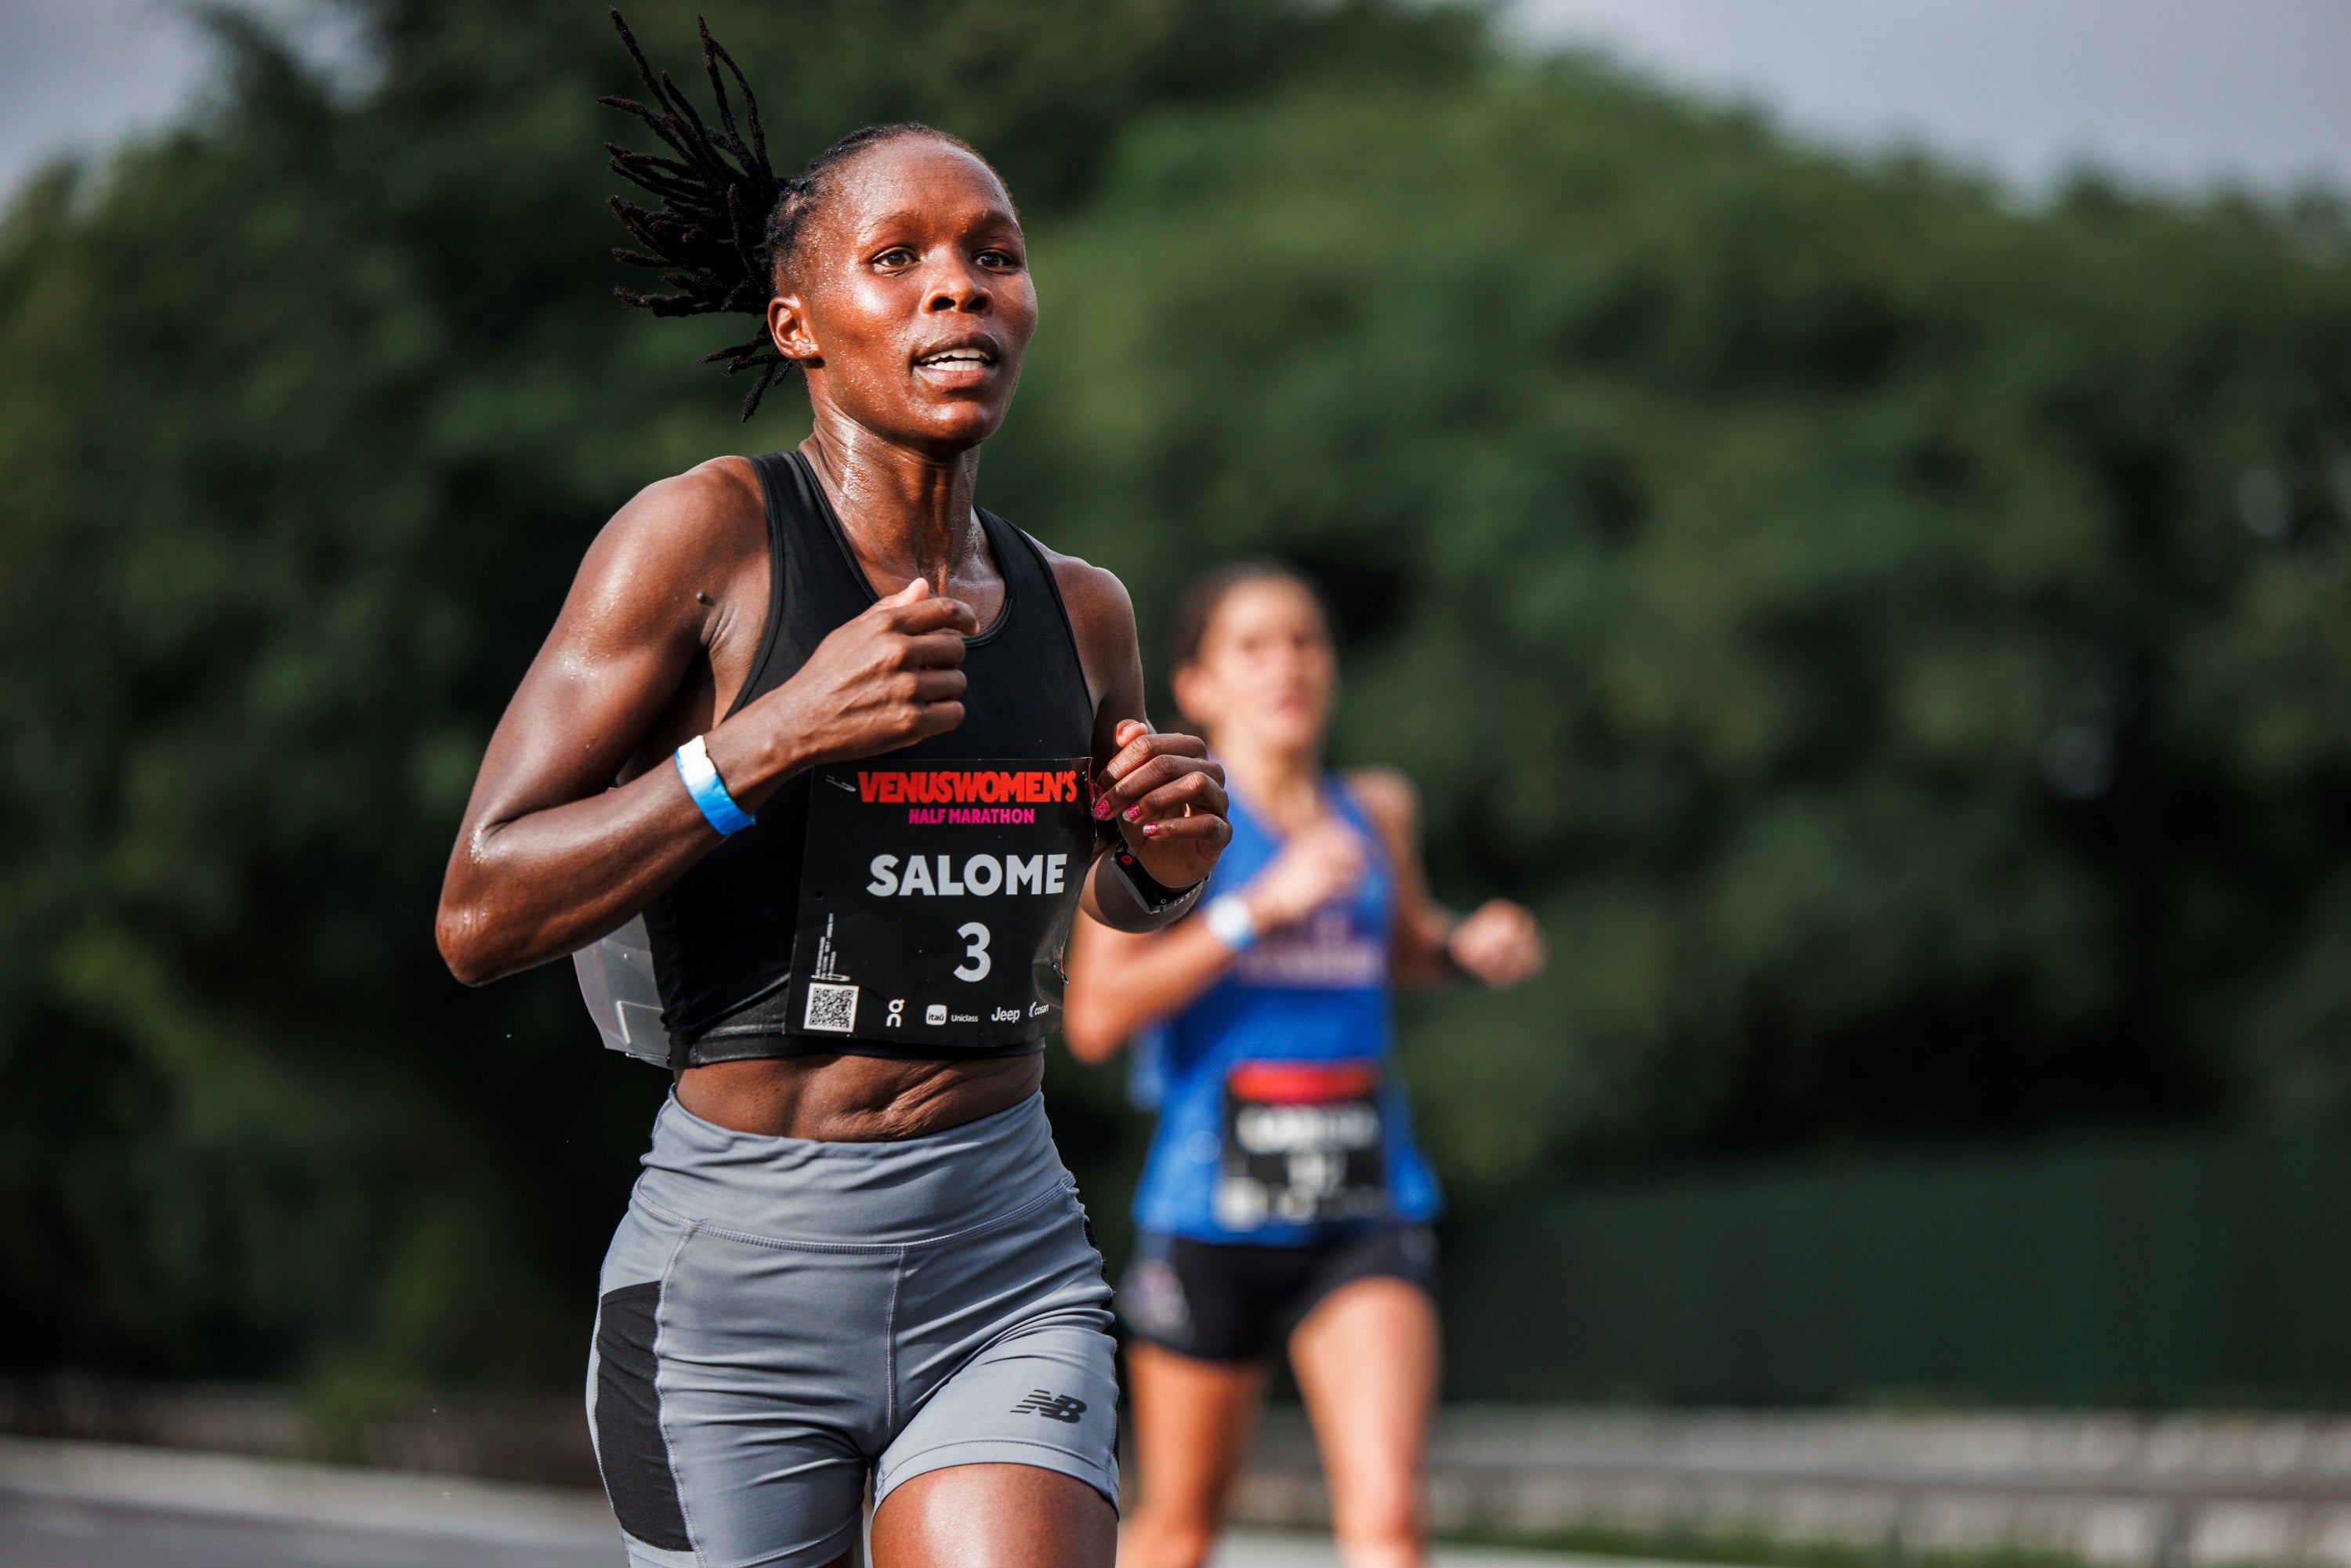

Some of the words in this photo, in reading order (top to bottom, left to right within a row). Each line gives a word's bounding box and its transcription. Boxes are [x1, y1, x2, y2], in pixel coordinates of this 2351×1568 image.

[908, 808, 946, 824] HALF
[948, 808, 1035, 824] MARATHON
[866, 853, 1068, 897] SALOME
[953, 921, 992, 983] 3
[951, 1013, 979, 1023] Uniclass
[991, 1006, 1020, 1023] Jeep
